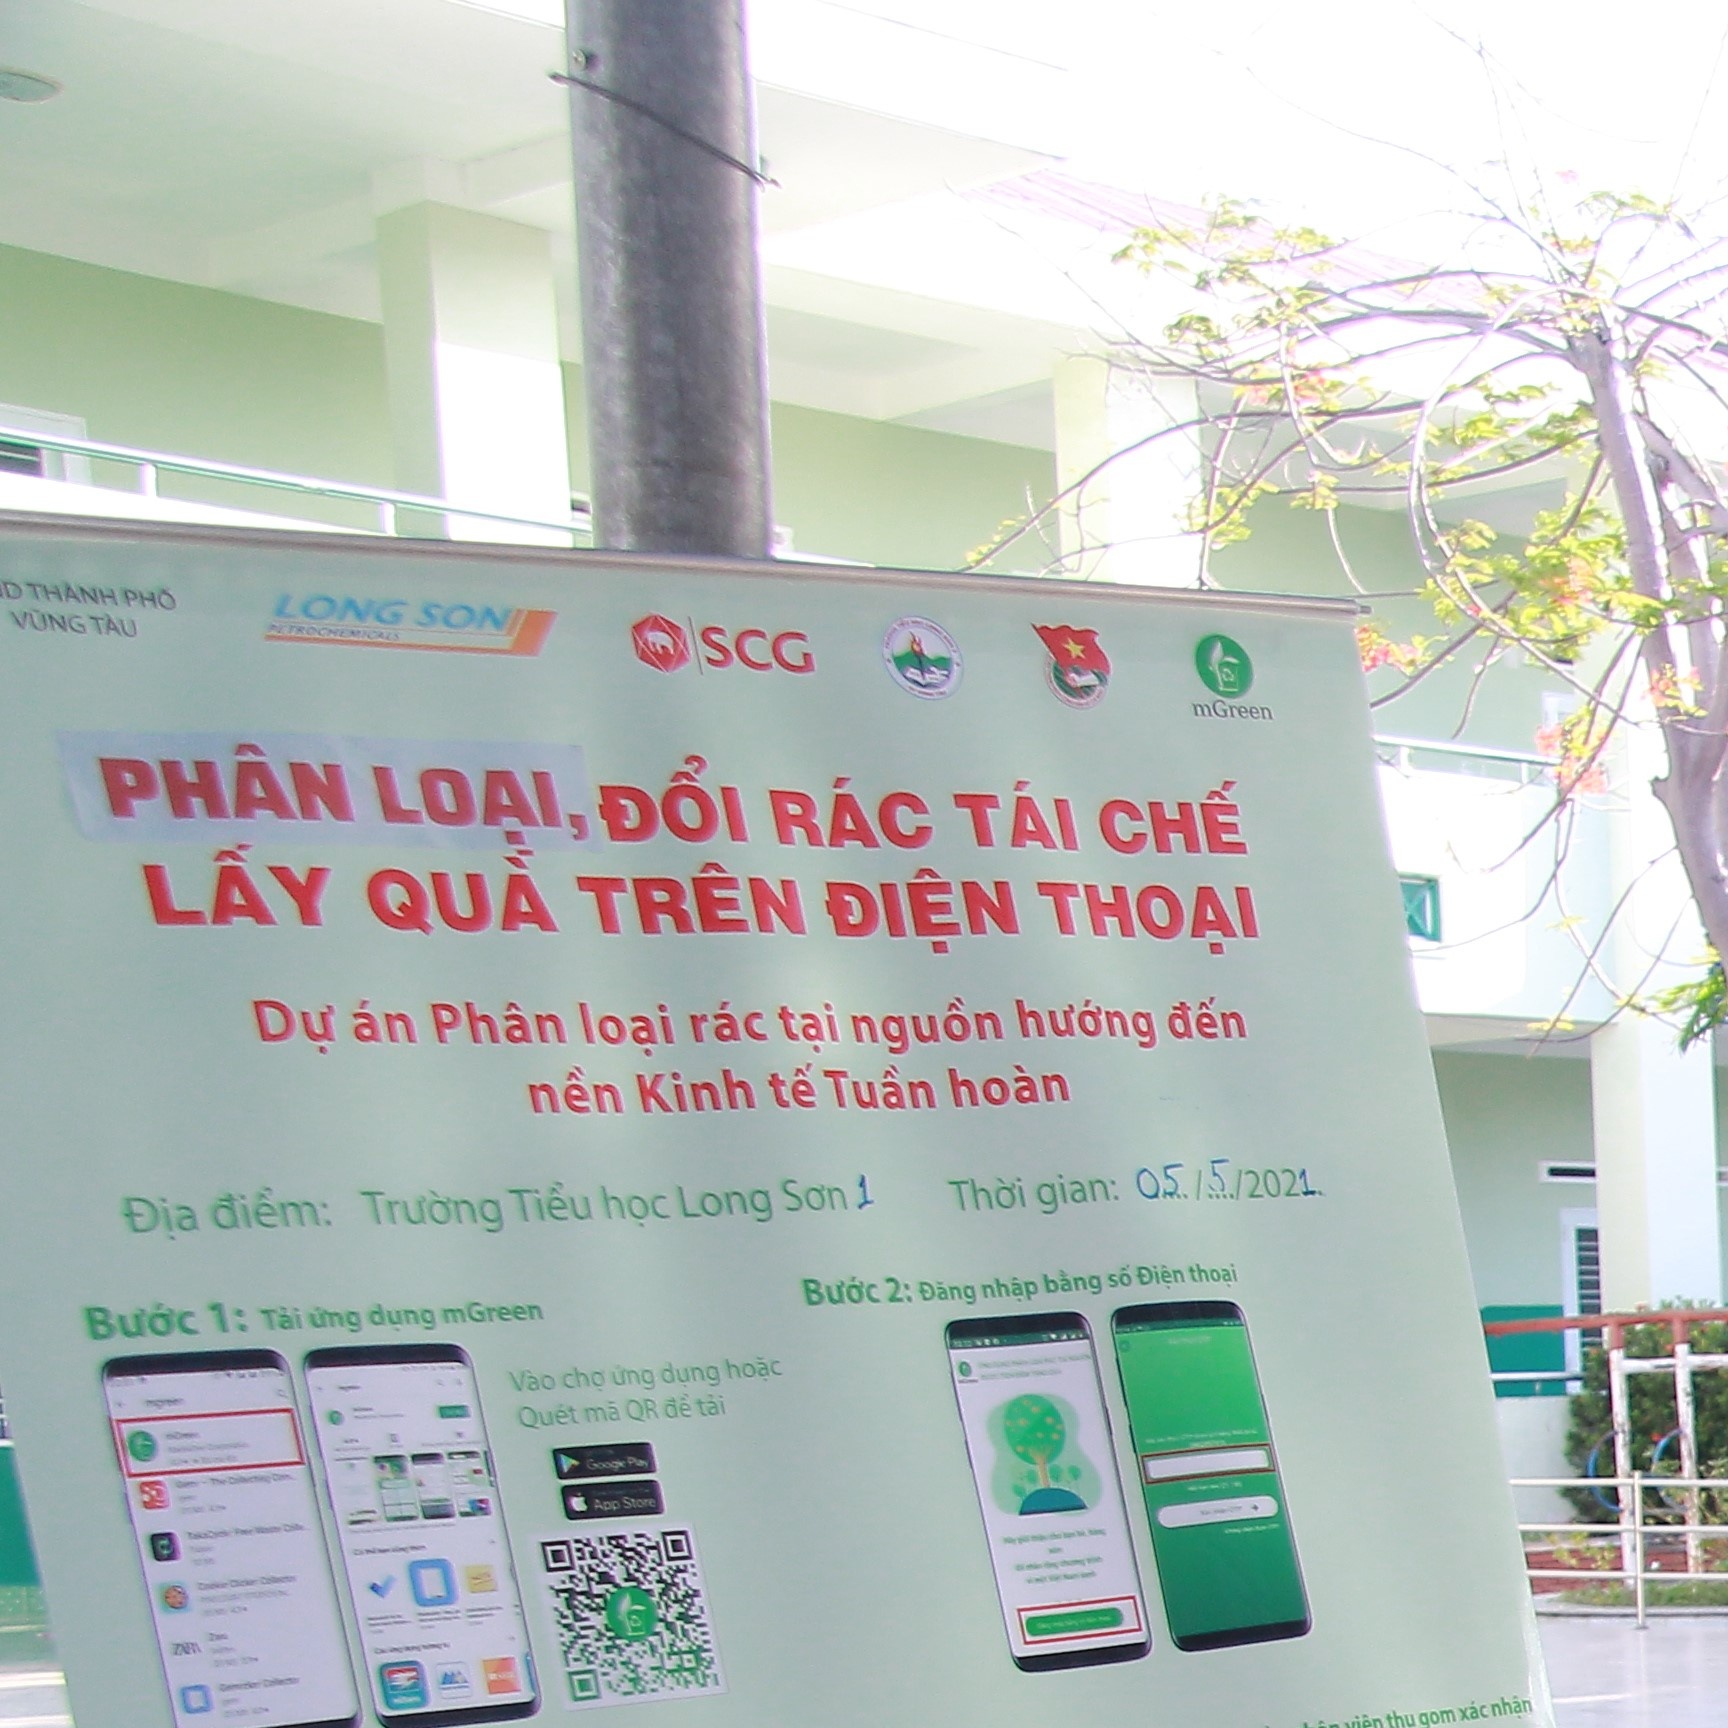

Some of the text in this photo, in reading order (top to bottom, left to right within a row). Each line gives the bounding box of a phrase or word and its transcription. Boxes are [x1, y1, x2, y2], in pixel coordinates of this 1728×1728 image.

[27, 582, 118, 606] THÀNH
[123, 587, 177, 611] PHỐ
[274, 594, 512, 632] LONG SON
[12, 610, 137, 637] VŨNG TÀU
[704, 625, 816, 674] SCG
[1193, 700, 1273, 720] mGreen
[99, 742, 355, 824] PHÂN
[599, 753, 747, 845] ĐỔI
[768, 778, 933, 850] RÁC
[953, 781, 1080, 851] TÁI
[1099, 781, 1249, 856] CHẾ
[142, 842, 1260, 955] LẤY QUÀ TRÊN ĐIỆN THOẠI
[251, 997, 1247, 1056] Dự án Phân loại rác tại nguồn hướng đến
[528, 1062, 1070, 1116] nền Kinh tế Tuần hoàn
[122, 1195, 200, 1241] Địa
[213, 1186, 332, 1230] điểm:
[360, 1189, 505, 1234] Trường
[508, 1182, 593, 1224] Tiểu
[599, 1183, 668, 1231] học
[677, 1178, 774, 1224] Long
[782, 1177, 850, 1211] Sơn
[947, 1176, 1028, 1214] Thời
[1035, 1174, 1120, 1216] gian:
[802, 1264, 1238, 1306] Bước 2: Đăng nhập bằng số Điện thoại
[86, 1302, 543, 1341] Bước 1: Tải ứng dụng mGreen
[509, 1356, 783, 1392] Vào chợ ứng dụng hoặc
[518, 1393, 726, 1429] Quét mã QR để tải
[586, 1452, 649, 1472] Google Play
[593, 1495, 656, 1512] App Store
[1459, 1702, 1488, 1721] xác
[1491, 1696, 1533, 1720] nhận
